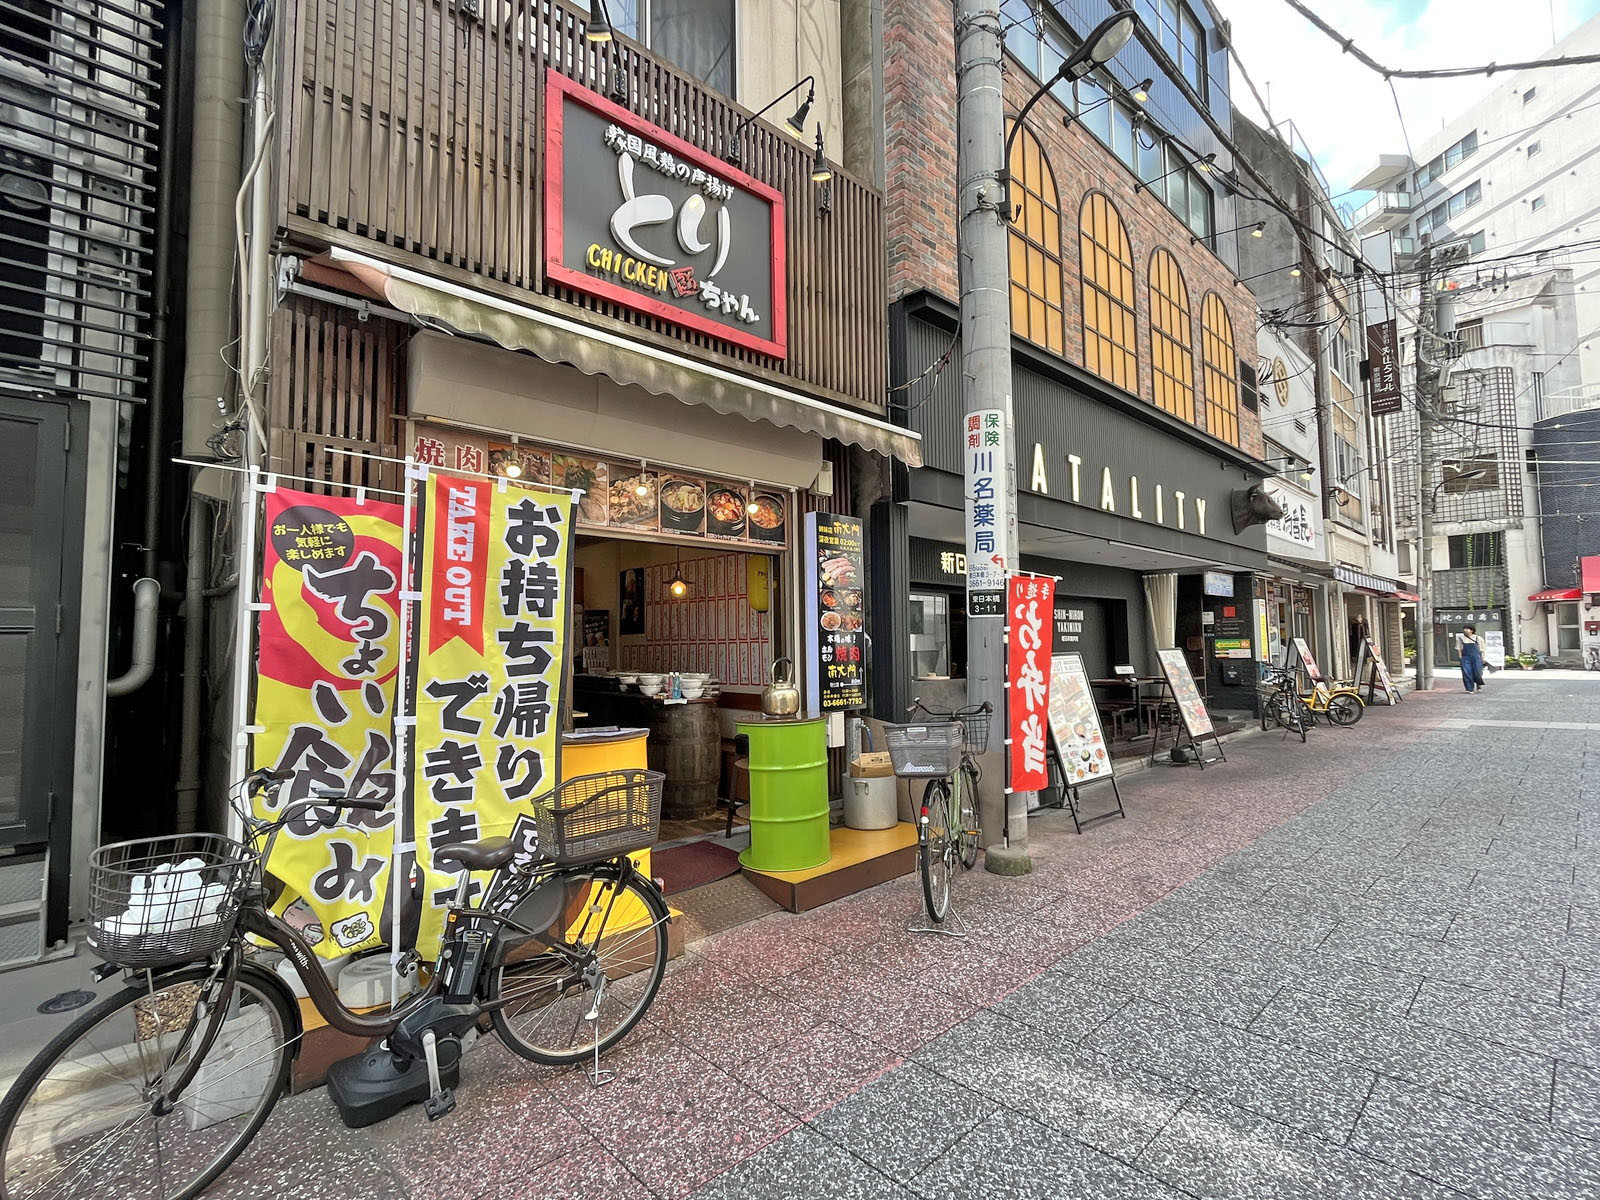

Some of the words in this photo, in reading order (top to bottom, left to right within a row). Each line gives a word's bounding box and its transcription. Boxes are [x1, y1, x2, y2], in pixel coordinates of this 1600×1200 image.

[610, 152, 731, 278] とり
[587, 244, 669, 292] CHICKEN
[699, 280, 760, 324] ちゃん
[968, 414, 981, 450] 調剤
[984, 413, 1000, 447] 保険
[414, 436, 484, 474] 焼肉
[973, 451, 995, 554] 川名薬局
[273, 522, 348, 536] お一人様でも
[295, 536, 333, 548] 気軽に
[447, 486, 476, 563] TAKE
[285, 545, 346, 560] 楽しめます
[443, 566, 471, 626] OUT
[974, 605, 997, 613] 3-11
[494, 498, 562, 801] お持ち帰り
[835, 645, 861, 662] 焼肉
[424, 672, 489, 908] できま
